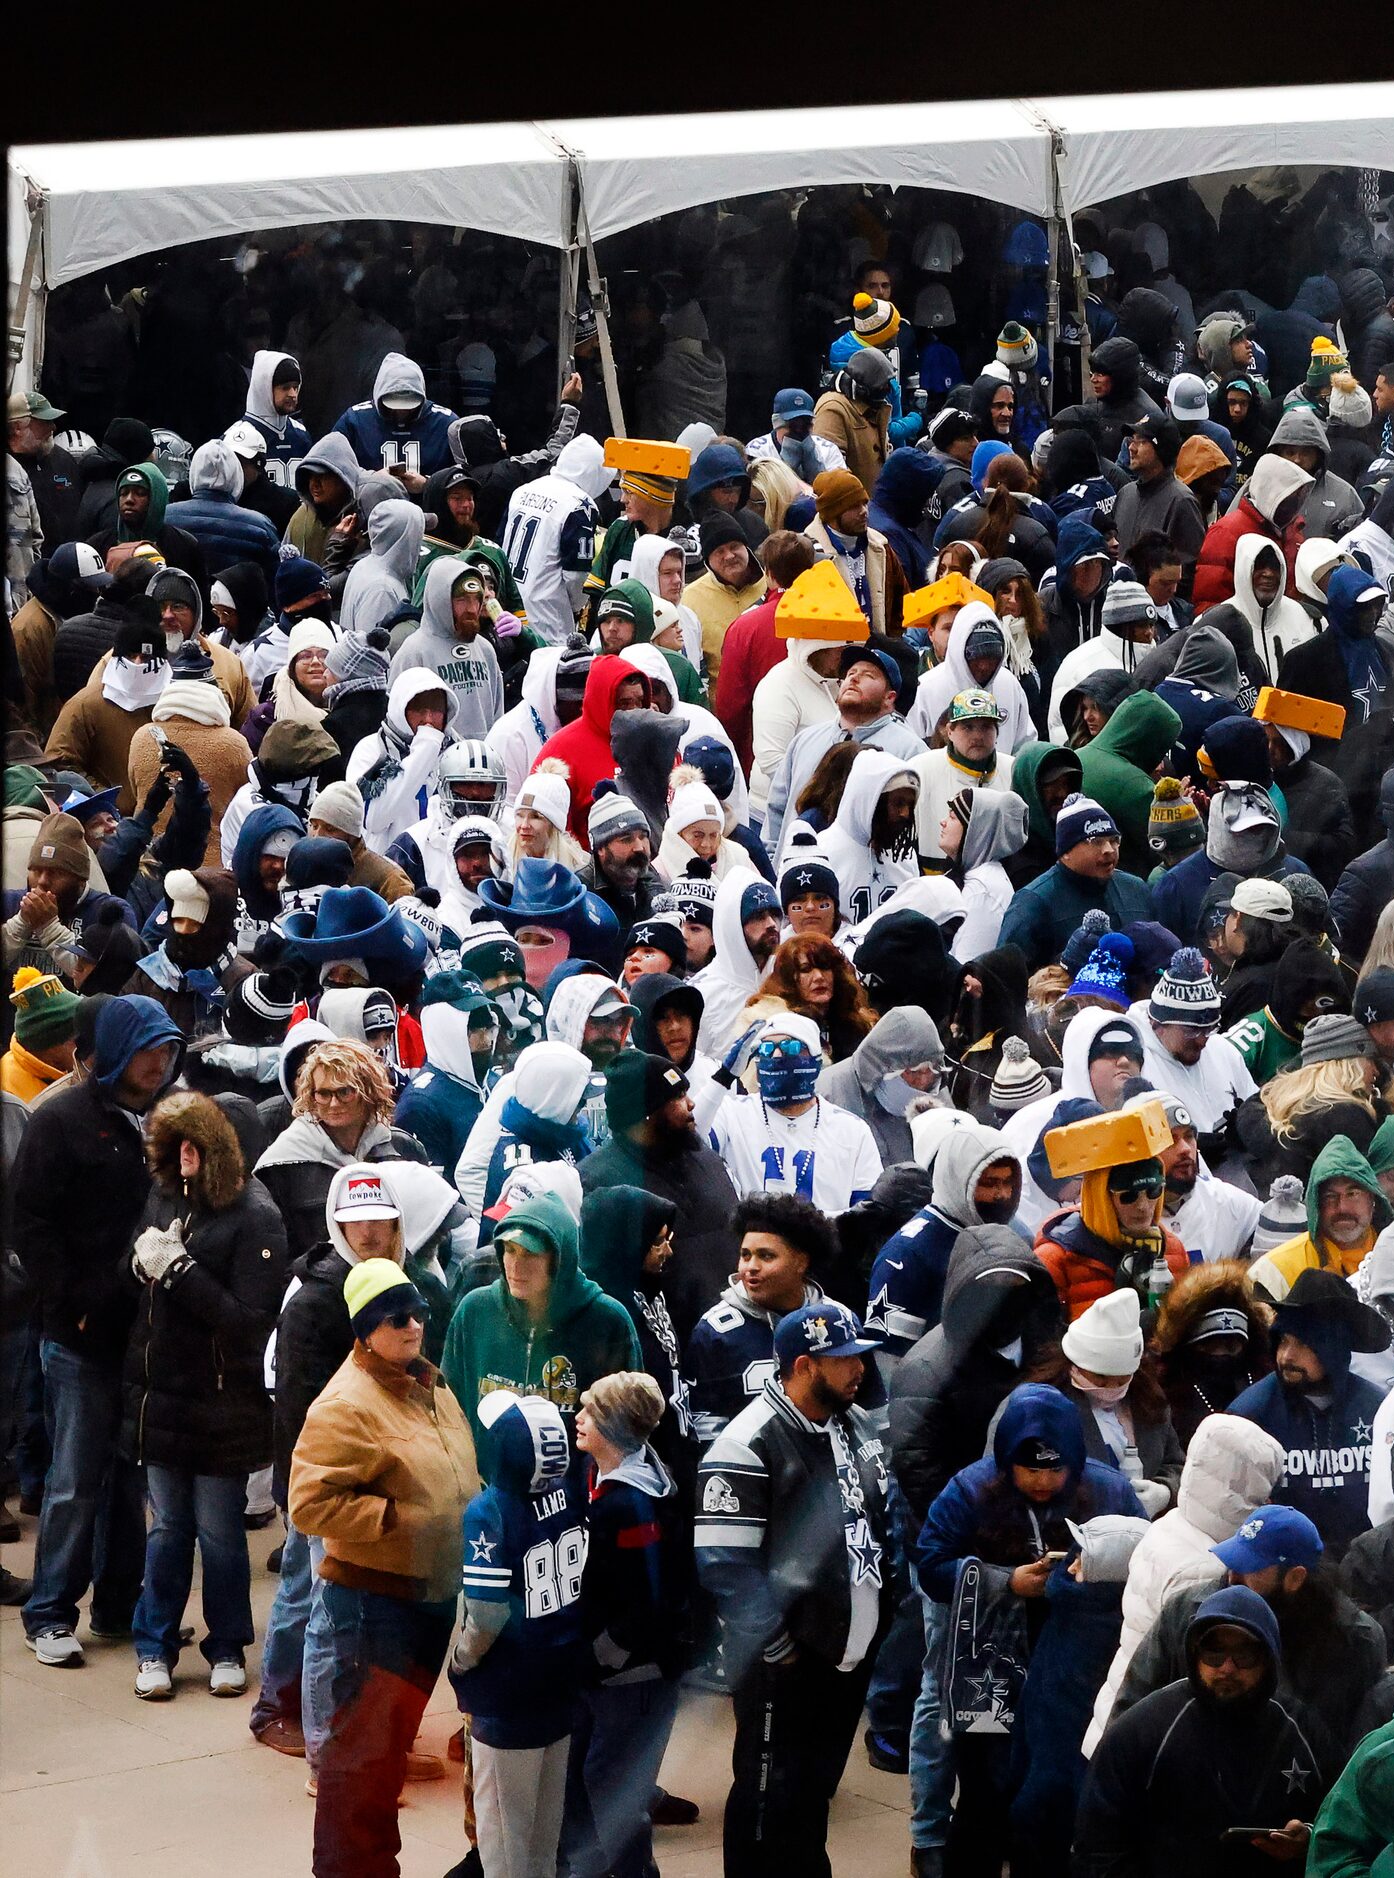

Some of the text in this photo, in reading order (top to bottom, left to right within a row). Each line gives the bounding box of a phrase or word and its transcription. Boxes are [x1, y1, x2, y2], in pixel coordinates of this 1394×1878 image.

[381, 440, 421, 475] 11
[519, 492, 557, 513] PARSONS
[506, 511, 541, 584] 11
[578, 536, 595, 560] 11
[1222, 1017, 1266, 1052] 12
[503, 1143, 533, 1171] 11
[761, 1145, 816, 1204] 11
[532, 1488, 567, 1522] LAMB
[523, 1525, 587, 1619] 88
